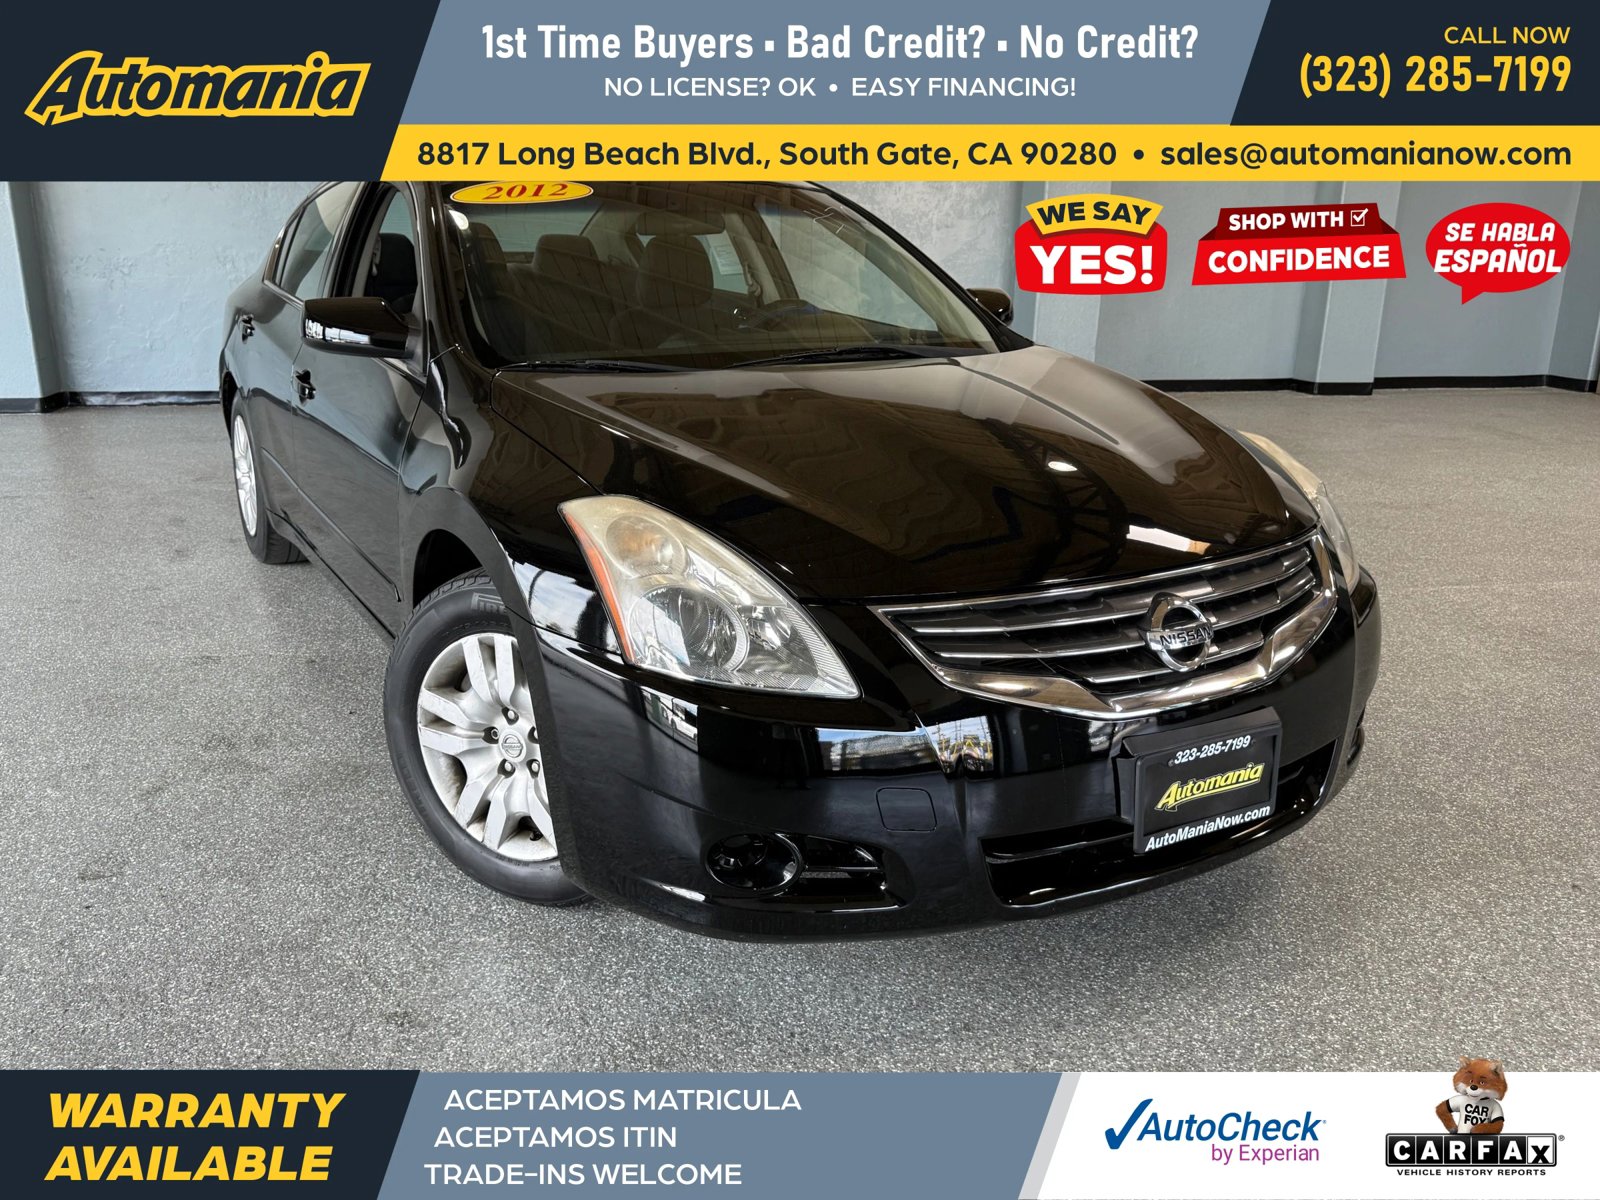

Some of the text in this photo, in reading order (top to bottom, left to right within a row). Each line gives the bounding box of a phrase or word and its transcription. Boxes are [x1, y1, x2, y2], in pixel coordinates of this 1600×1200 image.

[482, 182, 569, 201] 2012
[1160, 626, 1212, 646] NISSAN
[1174, 735, 1251, 765] 323-285-7199
[1154, 762, 1265, 812] Automania
[1144, 806, 1271, 852] AutoManiaNow.com
